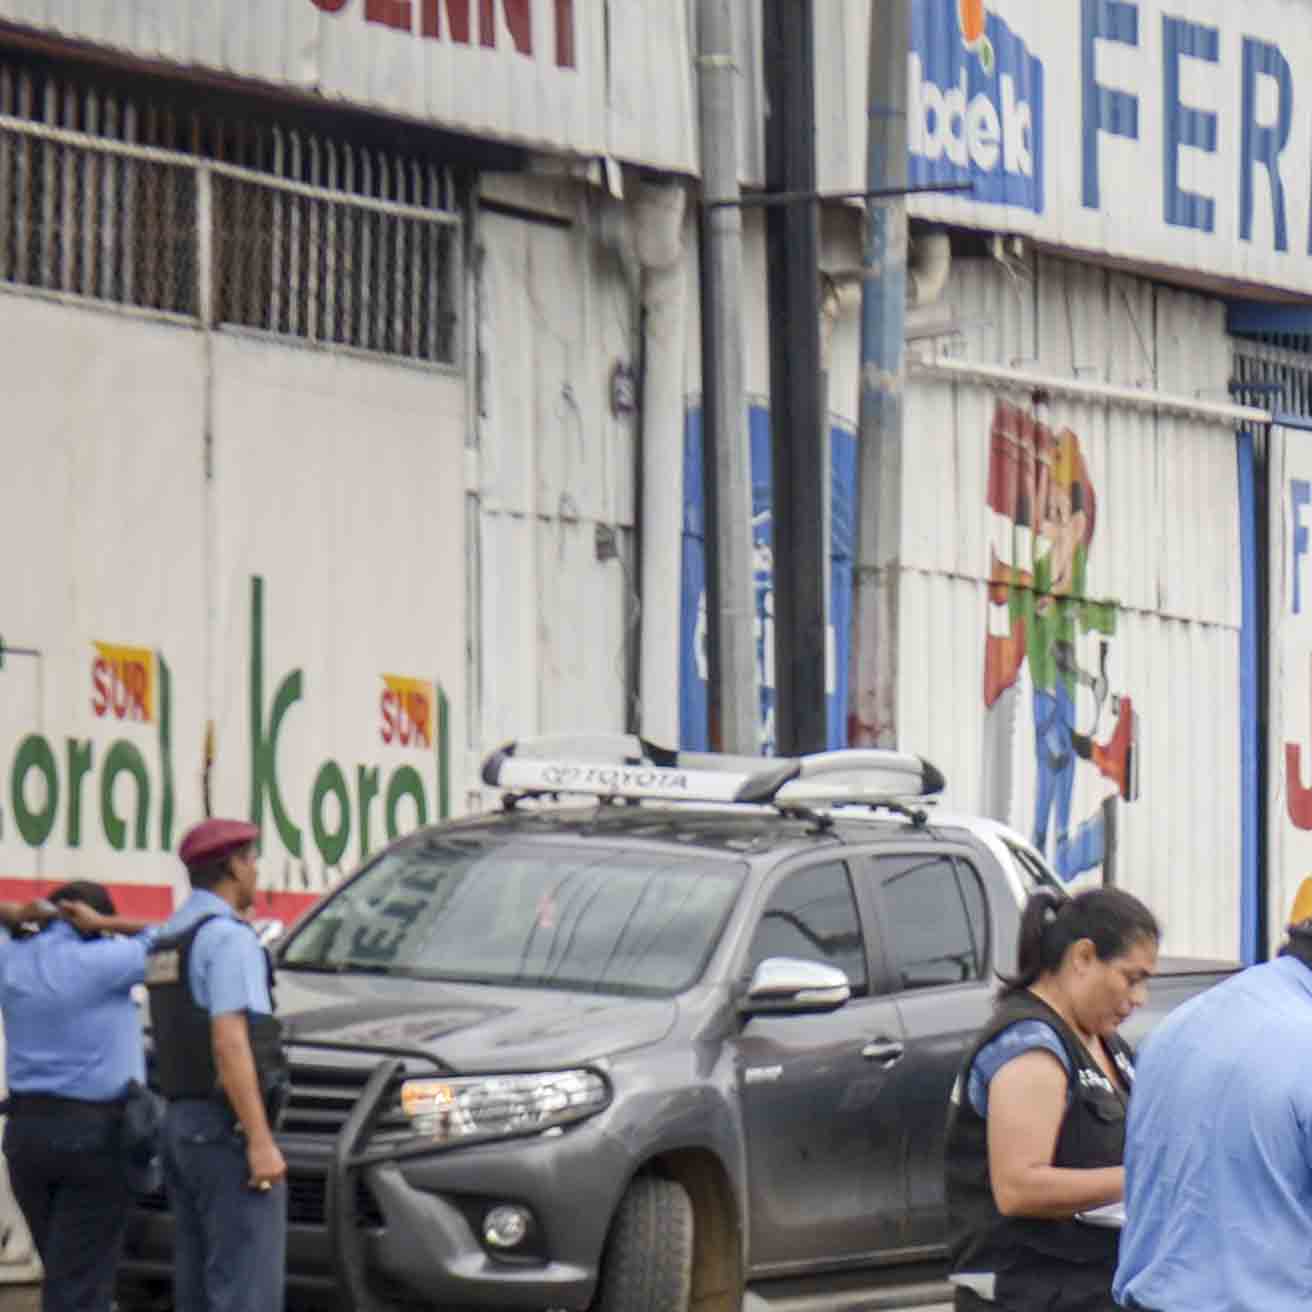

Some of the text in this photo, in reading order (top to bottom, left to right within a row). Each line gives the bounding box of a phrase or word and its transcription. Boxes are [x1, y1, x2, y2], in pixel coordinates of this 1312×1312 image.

[92, 656, 154, 722] SUR
[381, 687, 432, 749] SUR
[0, 633, 175, 852] oral
